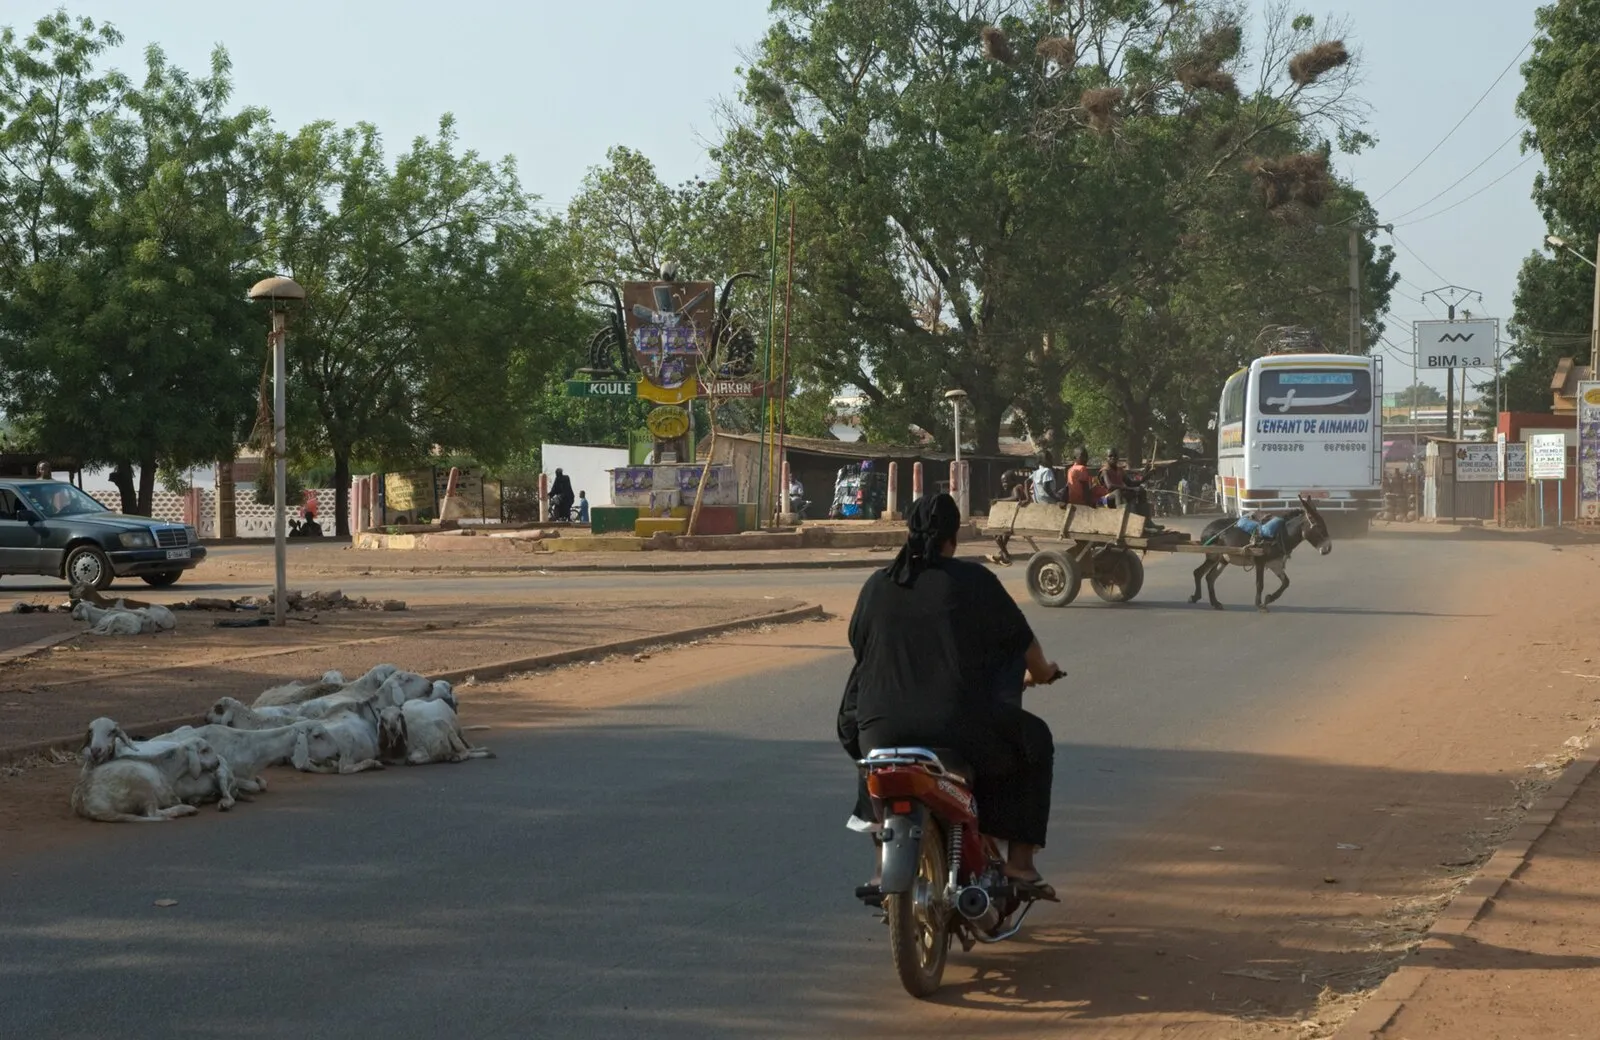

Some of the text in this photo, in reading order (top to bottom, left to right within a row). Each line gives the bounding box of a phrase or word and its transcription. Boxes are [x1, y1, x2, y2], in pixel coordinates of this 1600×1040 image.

[1428, 355, 1486, 367] BIM s.a.
[590, 382, 632, 395] KOULE
[1256, 419, 1369, 434] L'ENFANT DE AINAMADI
